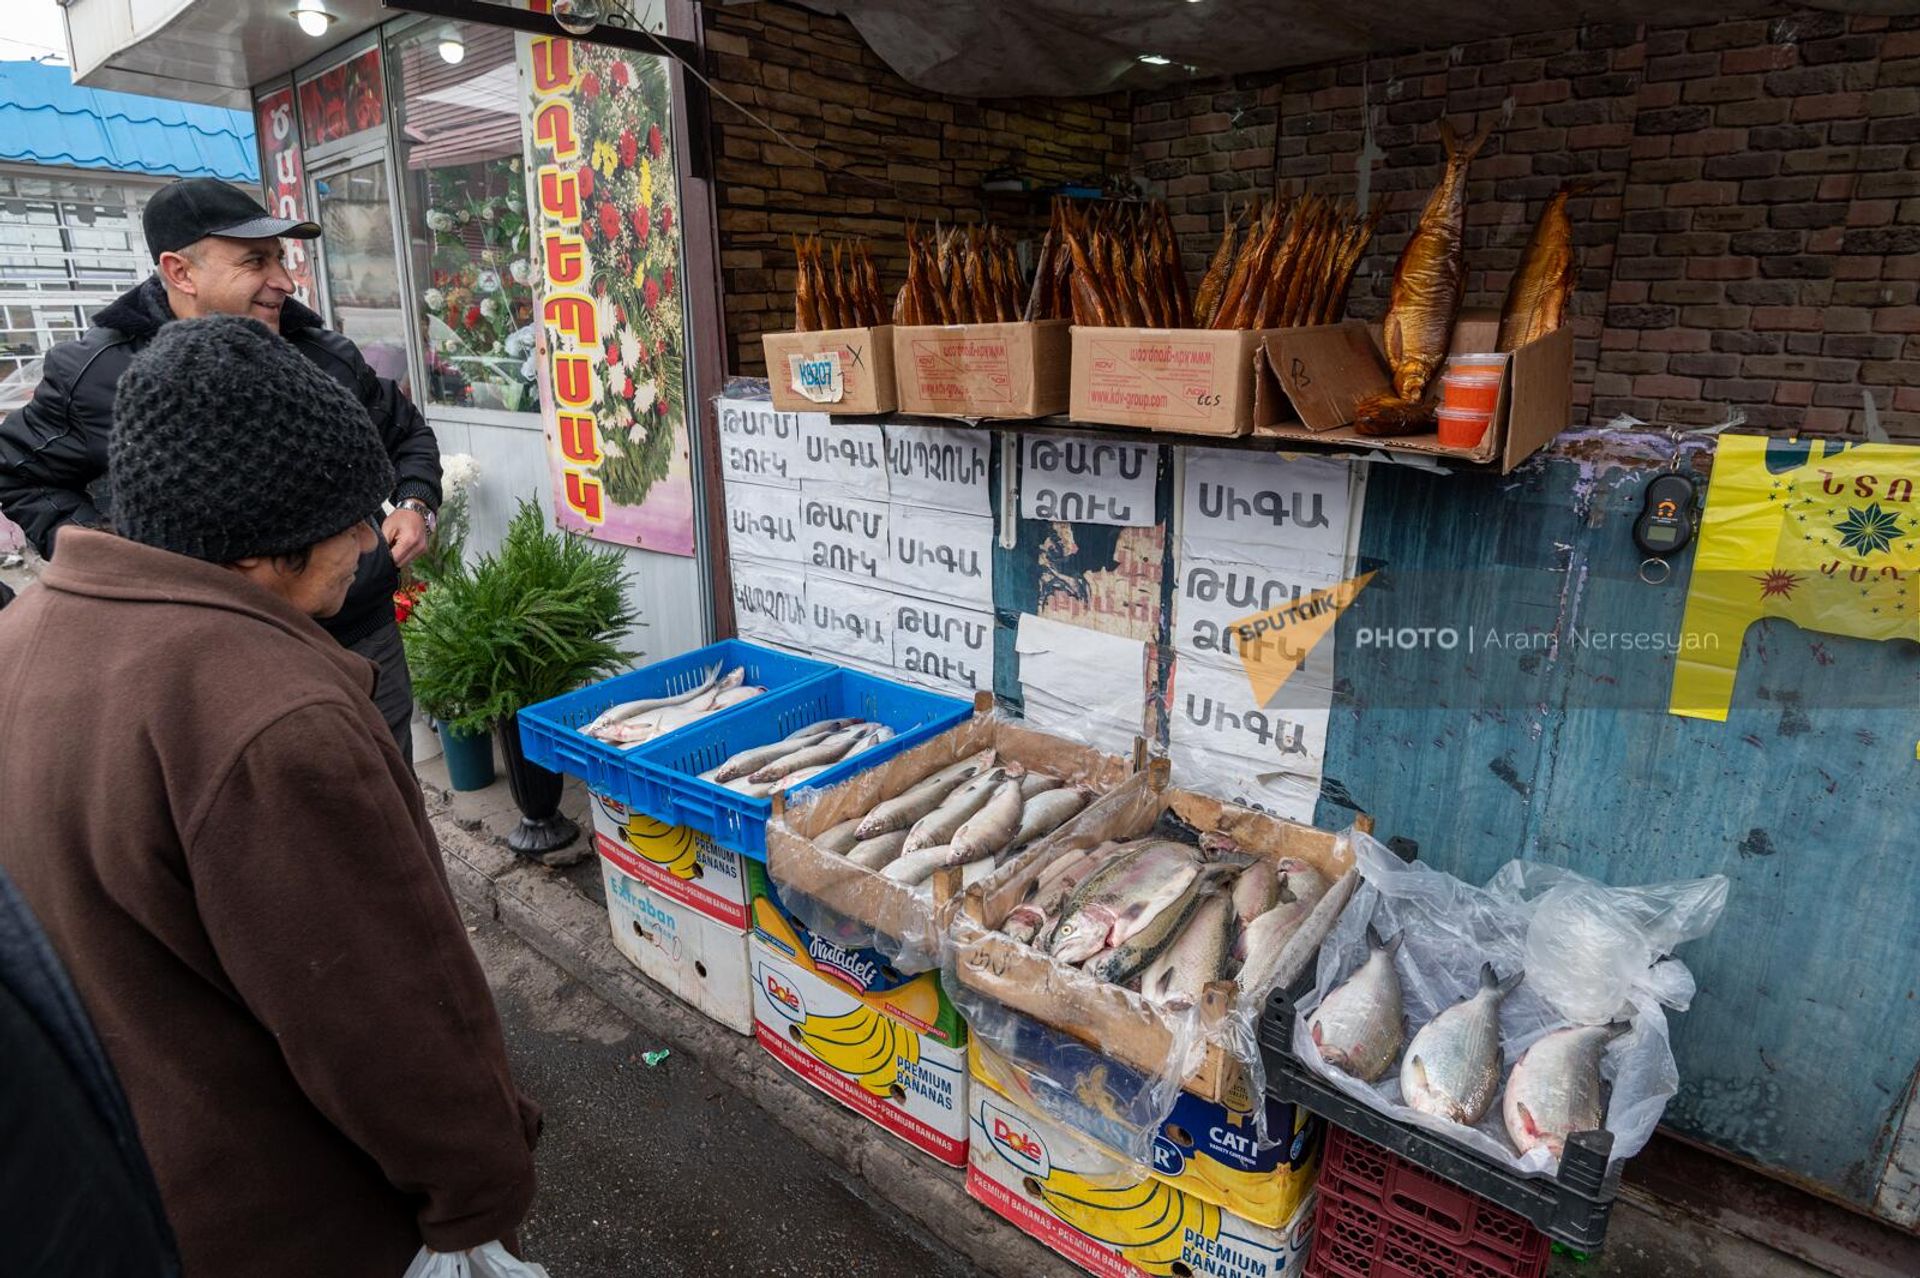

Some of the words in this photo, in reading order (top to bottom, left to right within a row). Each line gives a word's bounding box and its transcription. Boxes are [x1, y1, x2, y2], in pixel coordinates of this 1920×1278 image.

[530, 0, 604, 523] ԱՂԿԵՊՍԱԿ
[1091, 388, 1167, 410] www.kdv-group.com
[723, 408, 791, 439] ԹԱՐՄ
[730, 447, 787, 477] ՁՈՒԿ
[806, 436, 879, 468] ՍԻԳԱ
[887, 438, 985, 485] ԿԱՊՉՈՆԻ
[1030, 440, 1148, 480] ԹԱՐՄ
[733, 509, 796, 542] ՍԻԳԱ
[806, 501, 882, 539] ԹԱՐՄ
[1199, 483, 1329, 528] ՍԻԳԱ
[812, 541, 876, 577] ՁՈՒԿ
[898, 537, 981, 578] ՍԻԳԱ
[814, 604, 885, 645] ՍԻԳԱ
[897, 606, 987, 650] ԹԱՐՄ
[905, 646, 976, 689] ՁՈՒԿ
[1186, 693, 1308, 758] ՍԻԳԱ
[695, 837, 735, 863] PREMIUM
[696, 850, 737, 879] BANANAS
[808, 931, 878, 985] Frutadeli
[768, 975, 800, 1008] Dole
[897, 1055, 952, 1095] PREMIUM
[897, 1070, 953, 1111] BANANAS
[782, 1043, 811, 1068] BANANAS
[814, 1065, 845, 1090] PREMIUM
[844, 1081, 878, 1109] BANANAS
[881, 1105, 916, 1131] PREMIUM
[915, 1124, 953, 1151] BANANAS
[994, 1117, 1042, 1160] Dole
[1209, 1126, 1249, 1153] CAT
[973, 1173, 1010, 1205] PREMIUM
[1010, 1200, 1051, 1231] BANANAS
[1058, 1228, 1100, 1260] PREMIUM
[1184, 1227, 1267, 1278] PREMIUM
